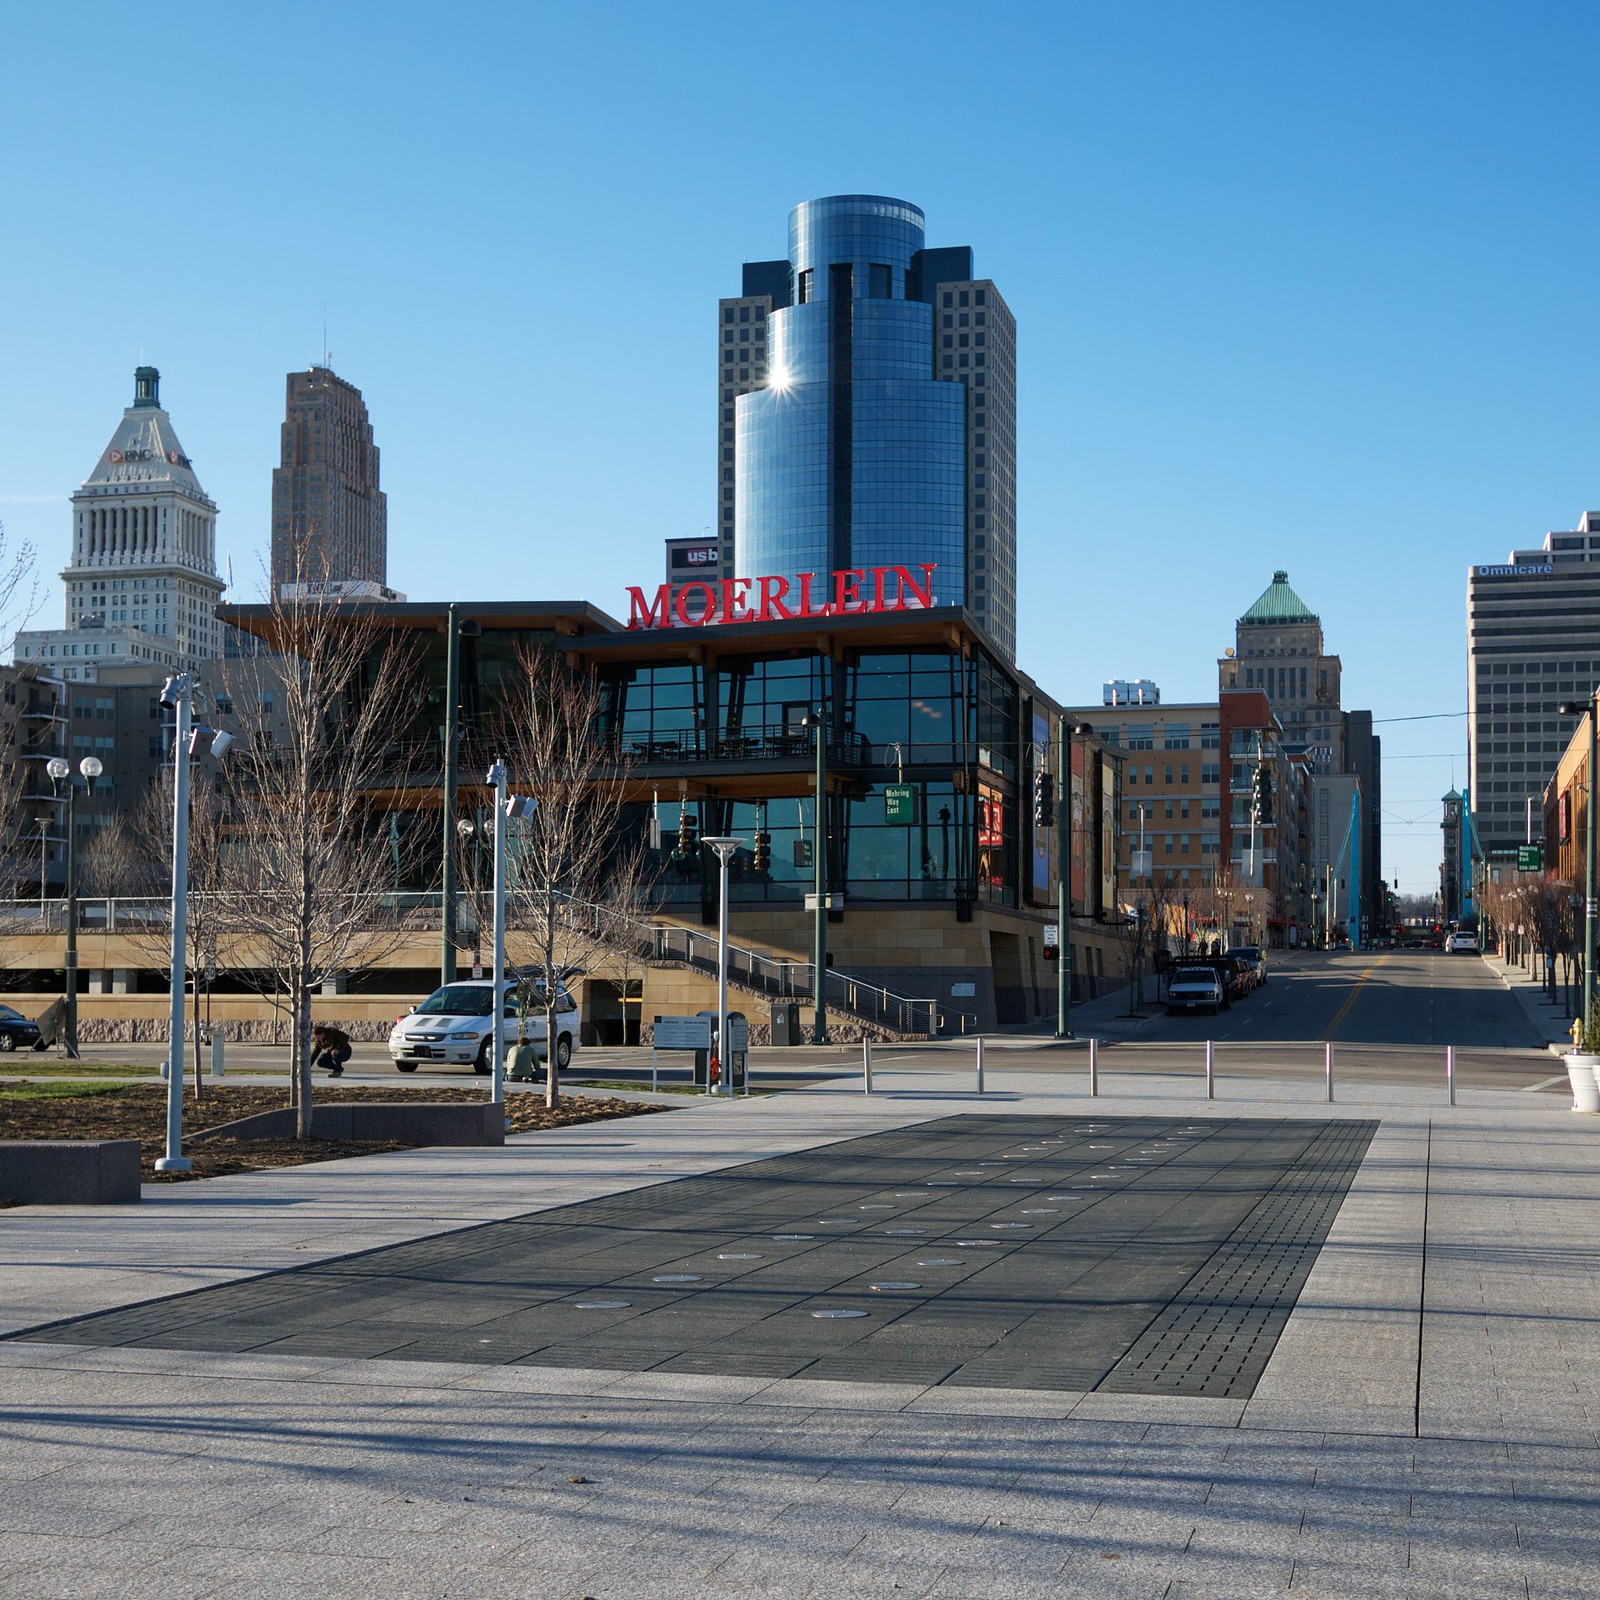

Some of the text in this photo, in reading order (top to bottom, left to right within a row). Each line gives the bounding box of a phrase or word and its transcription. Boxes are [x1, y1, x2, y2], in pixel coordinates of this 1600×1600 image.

[124, 449, 151, 462] PNC
[1479, 565, 1553, 576] Omnicare
[625, 563, 938, 631] MOERLEIN
[886, 789, 910, 798] Mehring
[887, 798, 900, 806] Way
[887, 806, 899, 814] East
